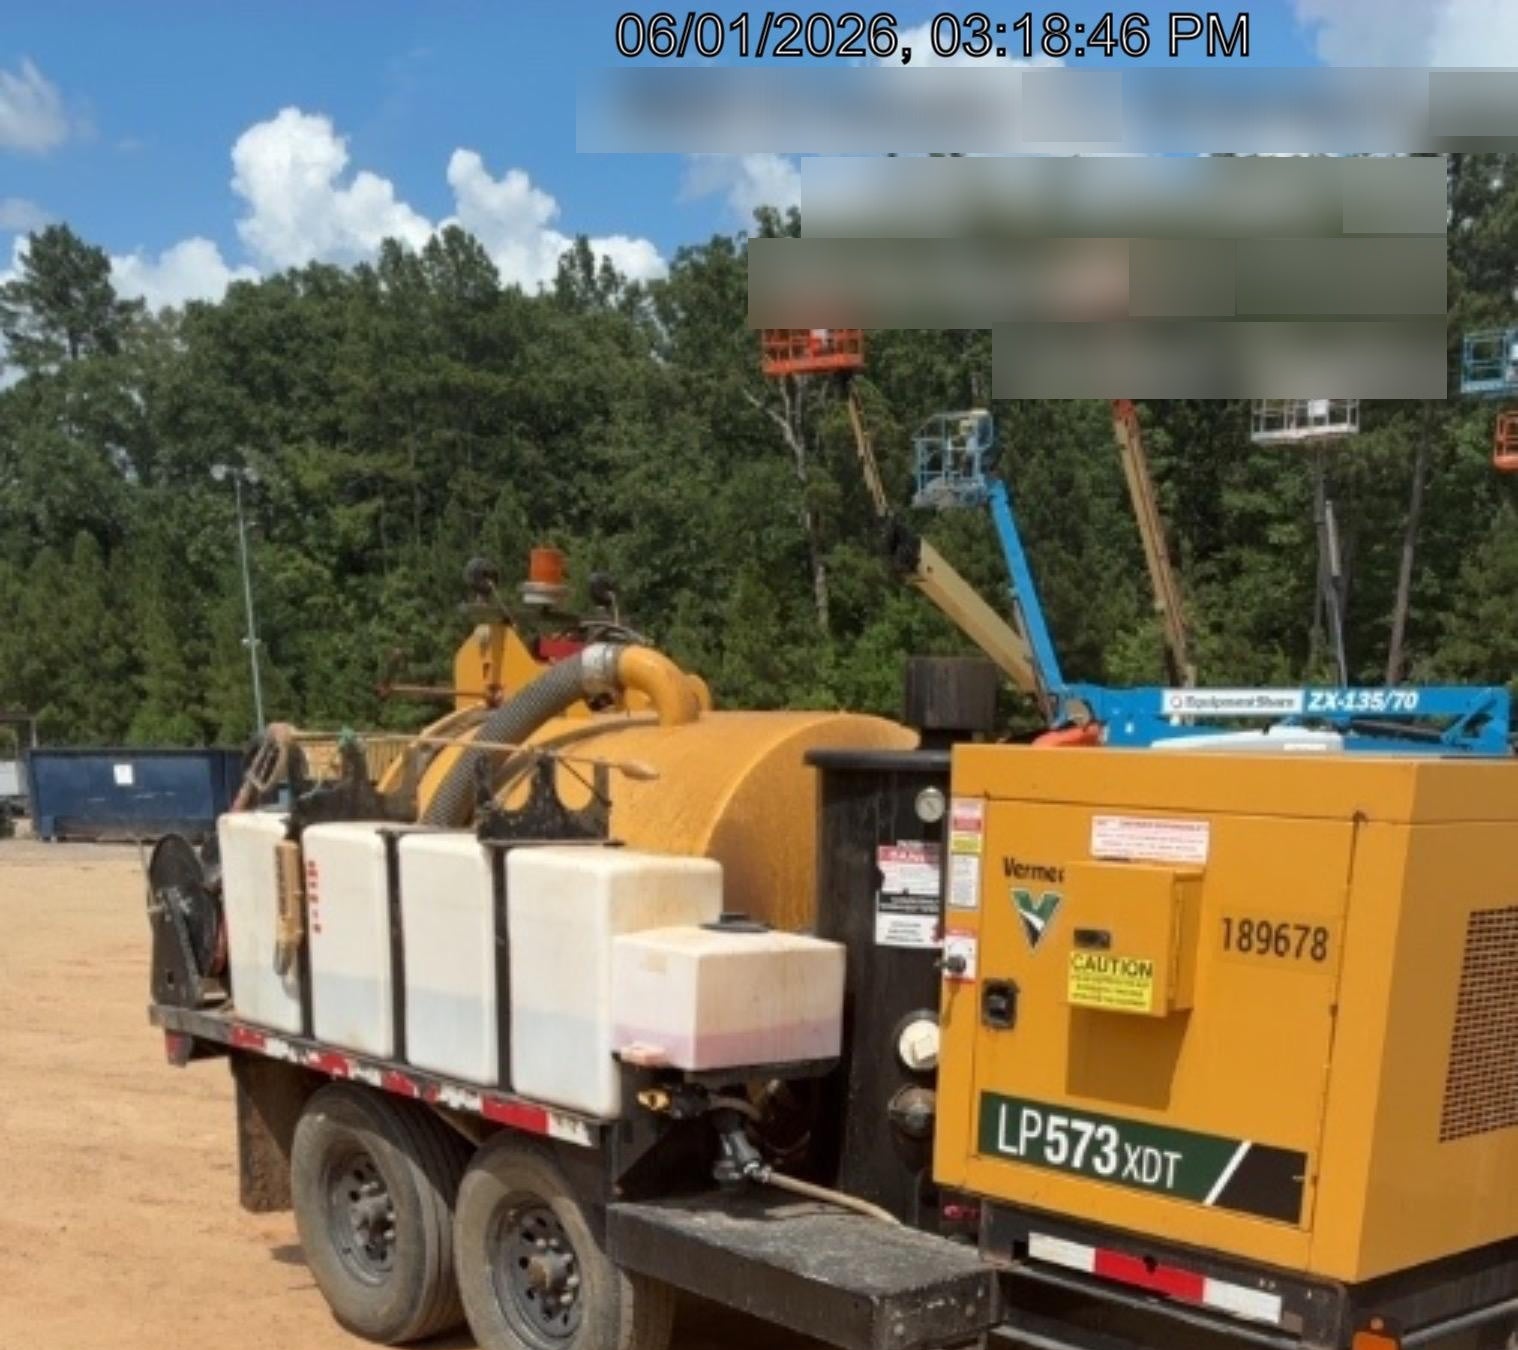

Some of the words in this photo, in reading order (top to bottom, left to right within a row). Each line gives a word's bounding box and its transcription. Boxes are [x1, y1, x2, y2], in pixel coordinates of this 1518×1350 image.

[1307, 690, 1419, 712] ZX-135/70
[1222, 917, 1329, 962] 189678
[1071, 953, 1153, 977] CAUTION
